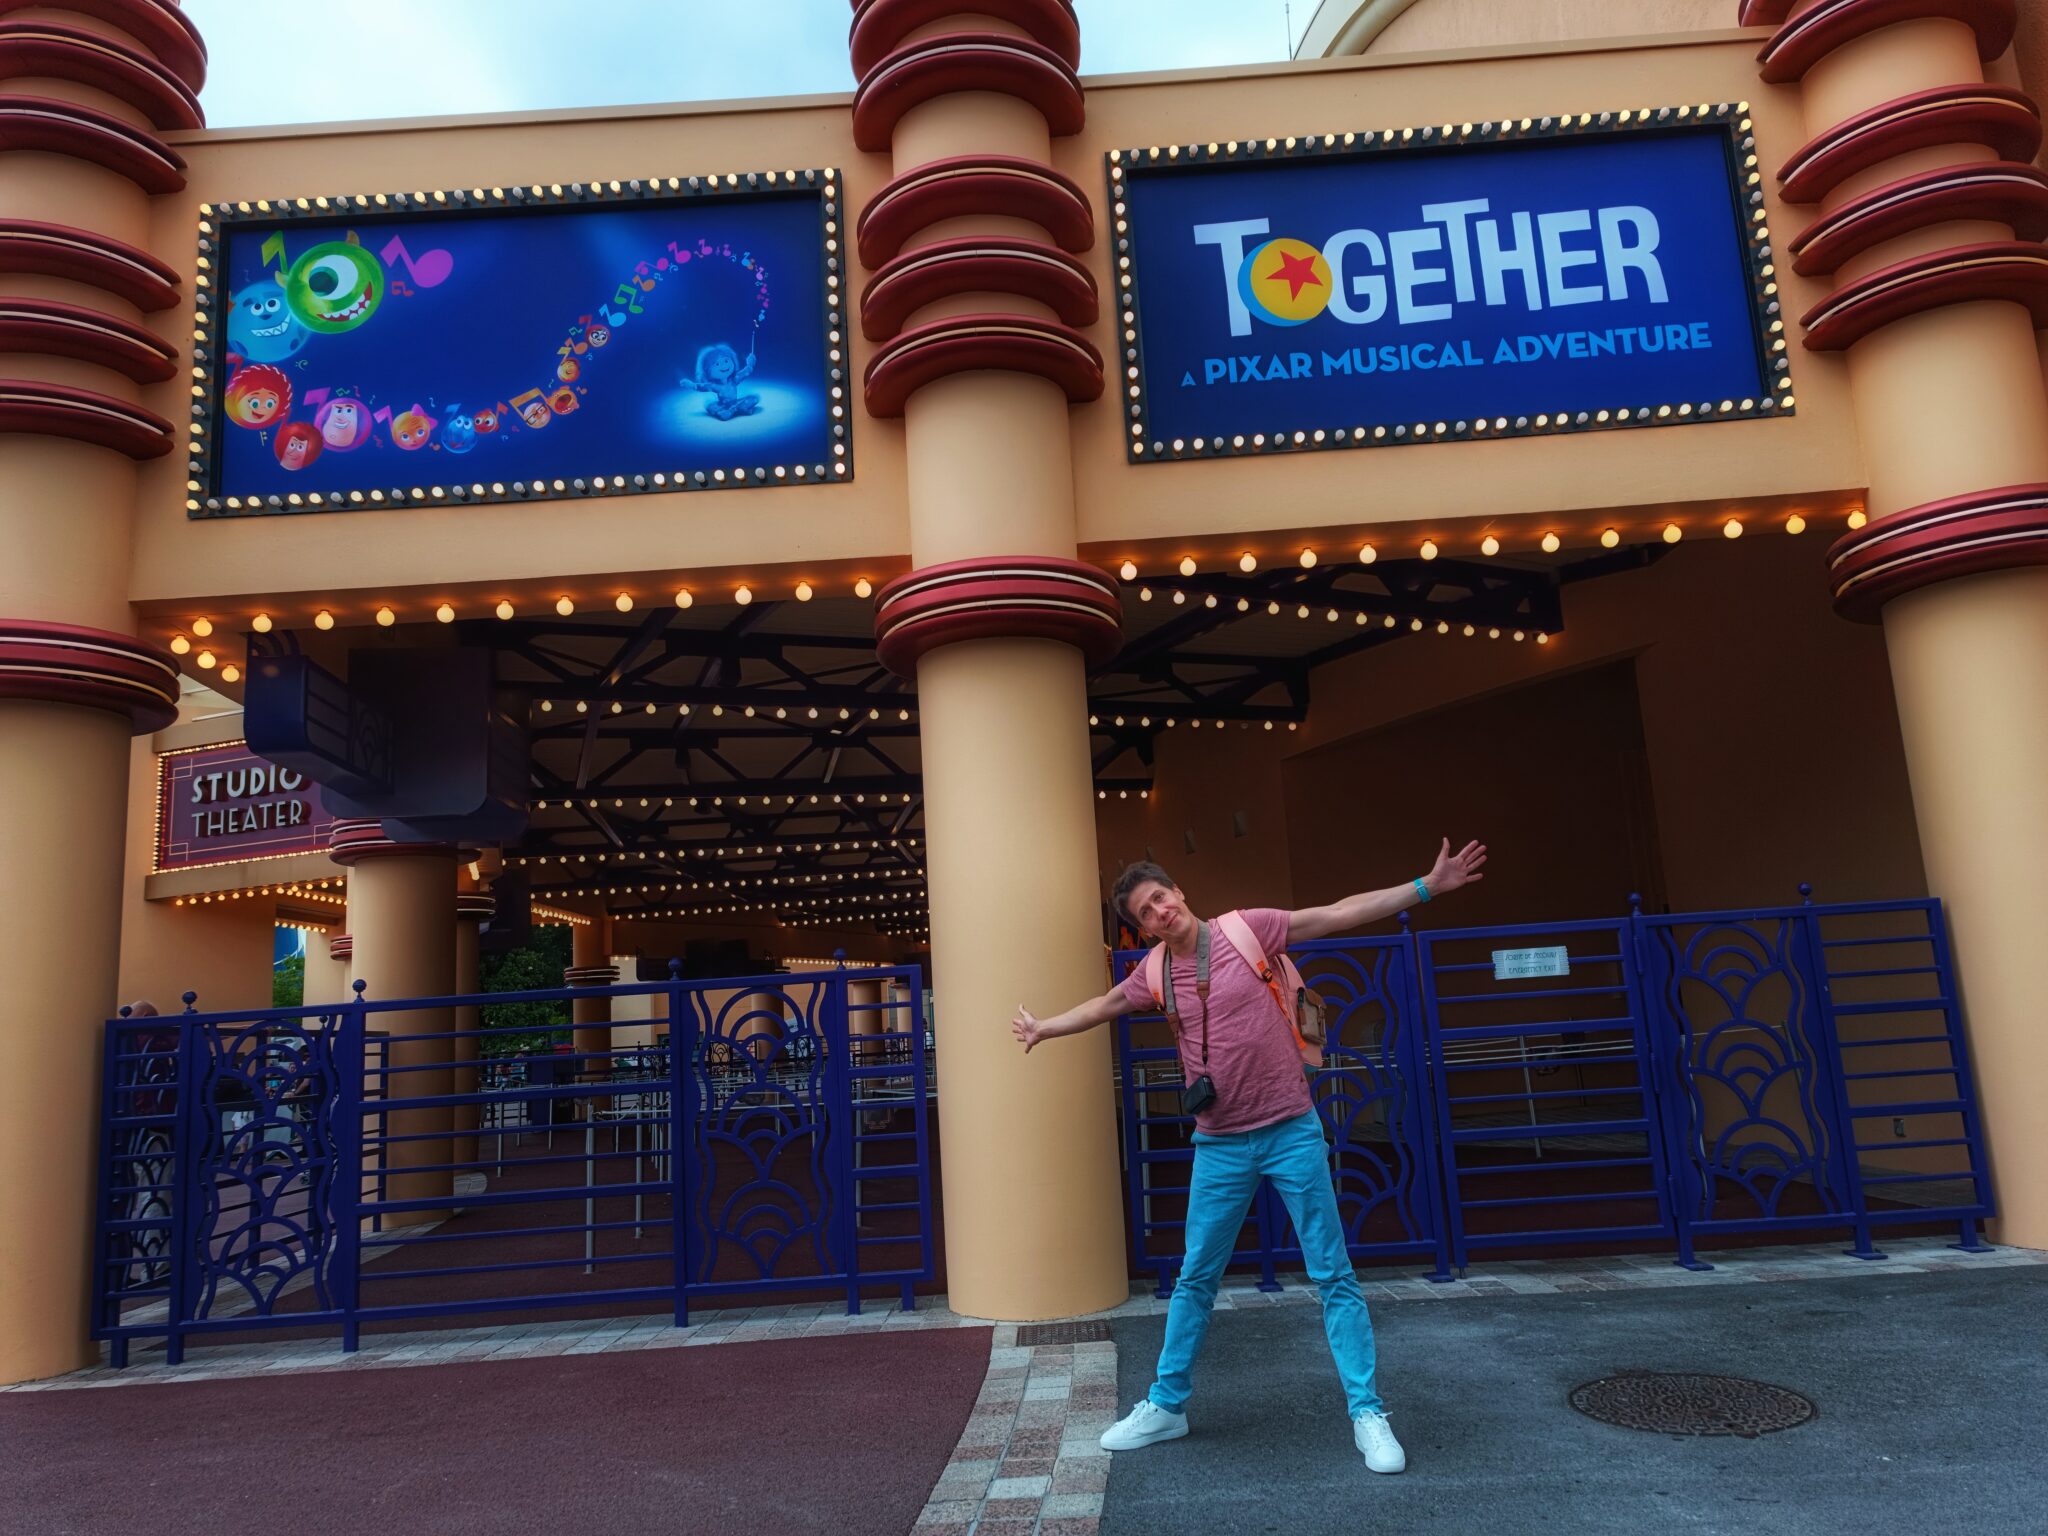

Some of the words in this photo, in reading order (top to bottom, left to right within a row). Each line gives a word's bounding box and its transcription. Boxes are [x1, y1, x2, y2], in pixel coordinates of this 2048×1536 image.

[1193, 198, 1669, 337] TOGETHER
[1181, 371, 1197, 387] A
[1204, 352, 1313, 385] PIXAR
[1321, 340, 1485, 376] MUSICAL
[1492, 322, 1713, 364] ADVENTURE
[191, 764, 302, 803] STUDIO
[191, 799, 303, 837] THEATER
